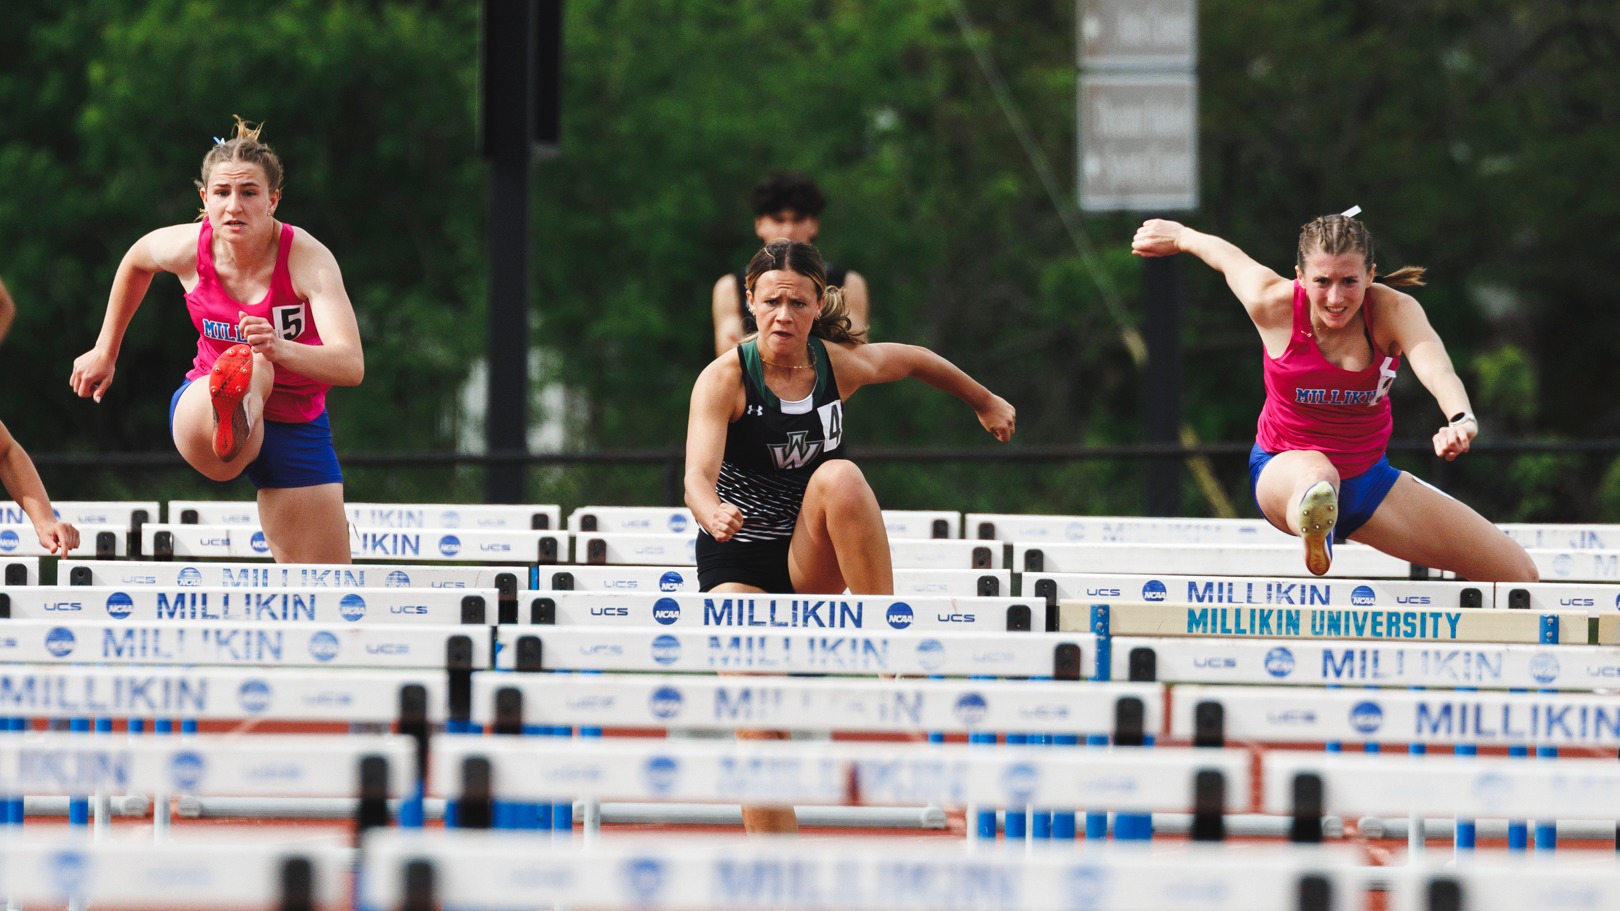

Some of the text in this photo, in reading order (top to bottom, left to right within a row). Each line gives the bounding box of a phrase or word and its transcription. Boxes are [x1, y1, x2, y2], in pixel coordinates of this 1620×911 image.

[281, 306, 301, 340] 5
[828, 404, 841, 445] 4
[480, 544, 511, 552] UCS
[122, 576, 156, 584] UCS
[431, 581, 466, 589] UCS
[604, 580, 638, 589] UCS
[1086, 588, 1121, 597] UCS
[1187, 580, 1331, 606] MILLIKIN
[1396, 596, 1431, 605] UCS
[44, 602, 82, 611] UCS
[157, 592, 316, 621] MILLIKIN
[390, 605, 428, 614] UCS
[591, 607, 629, 616] UCS
[703, 599, 863, 629] MILLIKIN
[938, 613, 975, 623] UCS
[1560, 598, 1594, 607] UCS
[1187, 608, 1462, 640] MILLIKIN UNIVERSITY
[0, 638, 17, 647] CS
[1415, 701, 1620, 739] MILLIKIN
